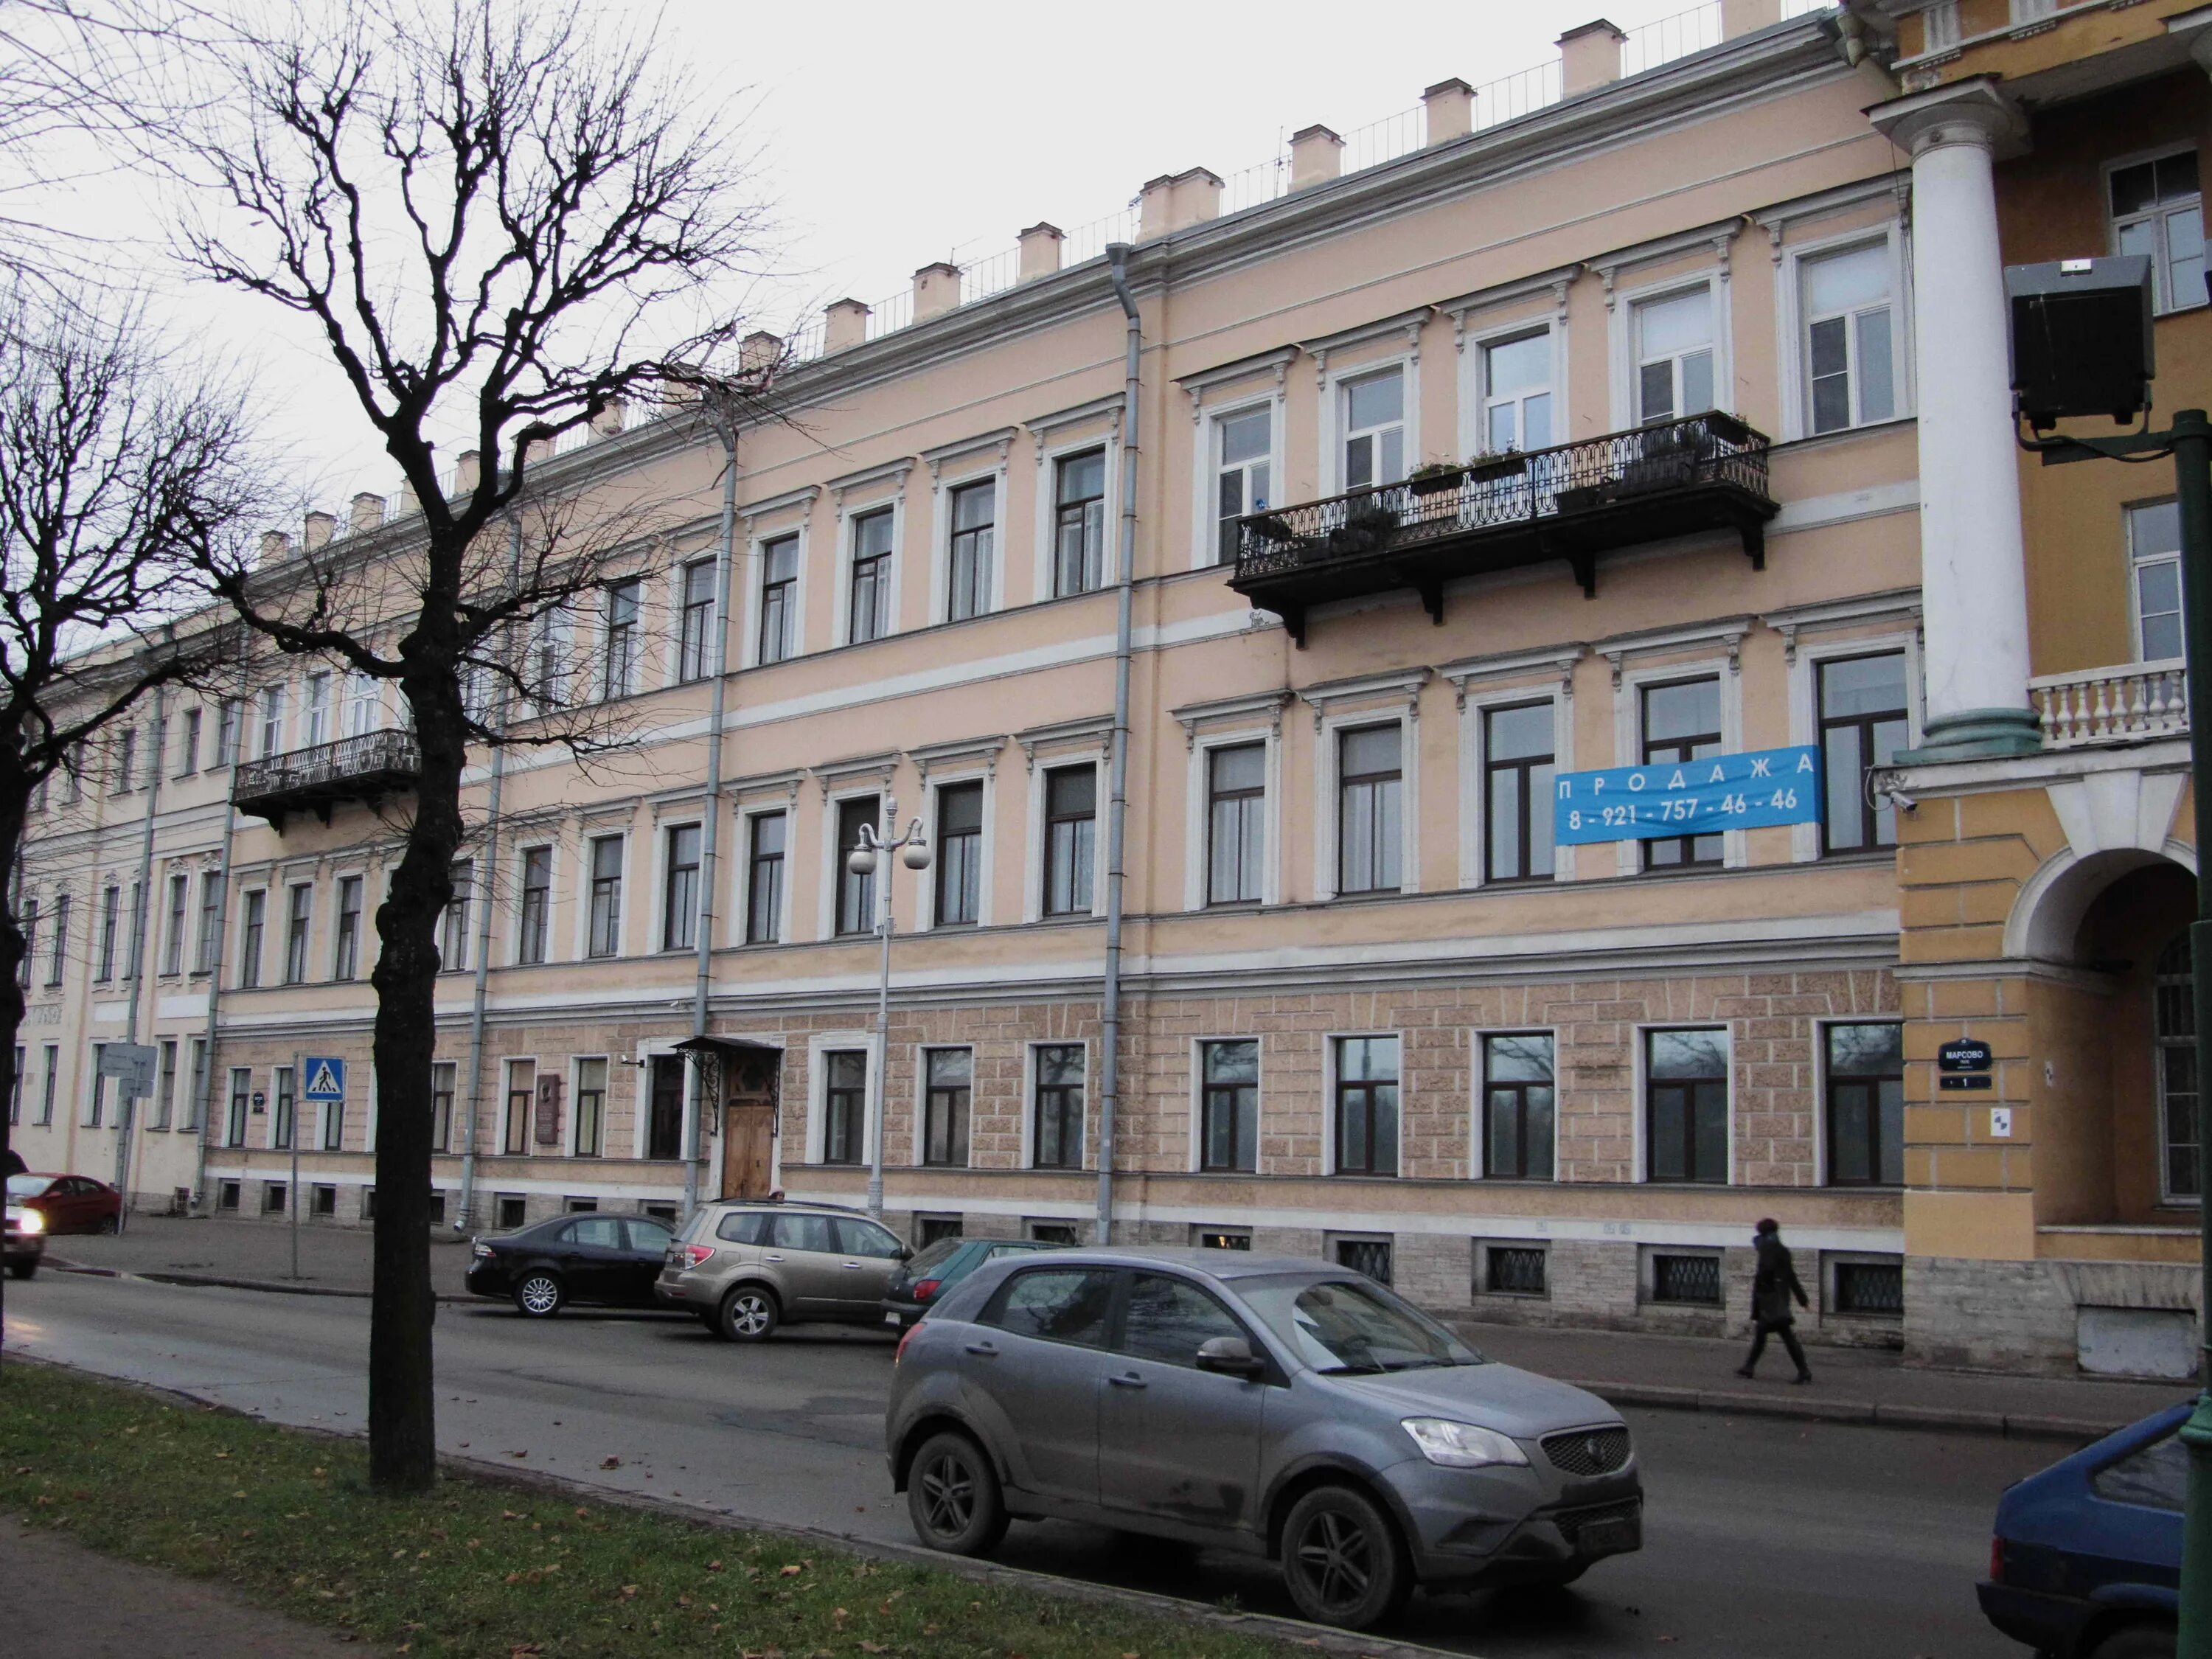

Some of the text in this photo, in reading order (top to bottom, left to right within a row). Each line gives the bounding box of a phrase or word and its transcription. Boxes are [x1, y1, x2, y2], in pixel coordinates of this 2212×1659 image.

[1559, 754, 1815, 799] ПРОДАЖА
[1946, 1050, 1983, 1060] МАРСОВО
[1963, 1078, 1968, 1088] 1
